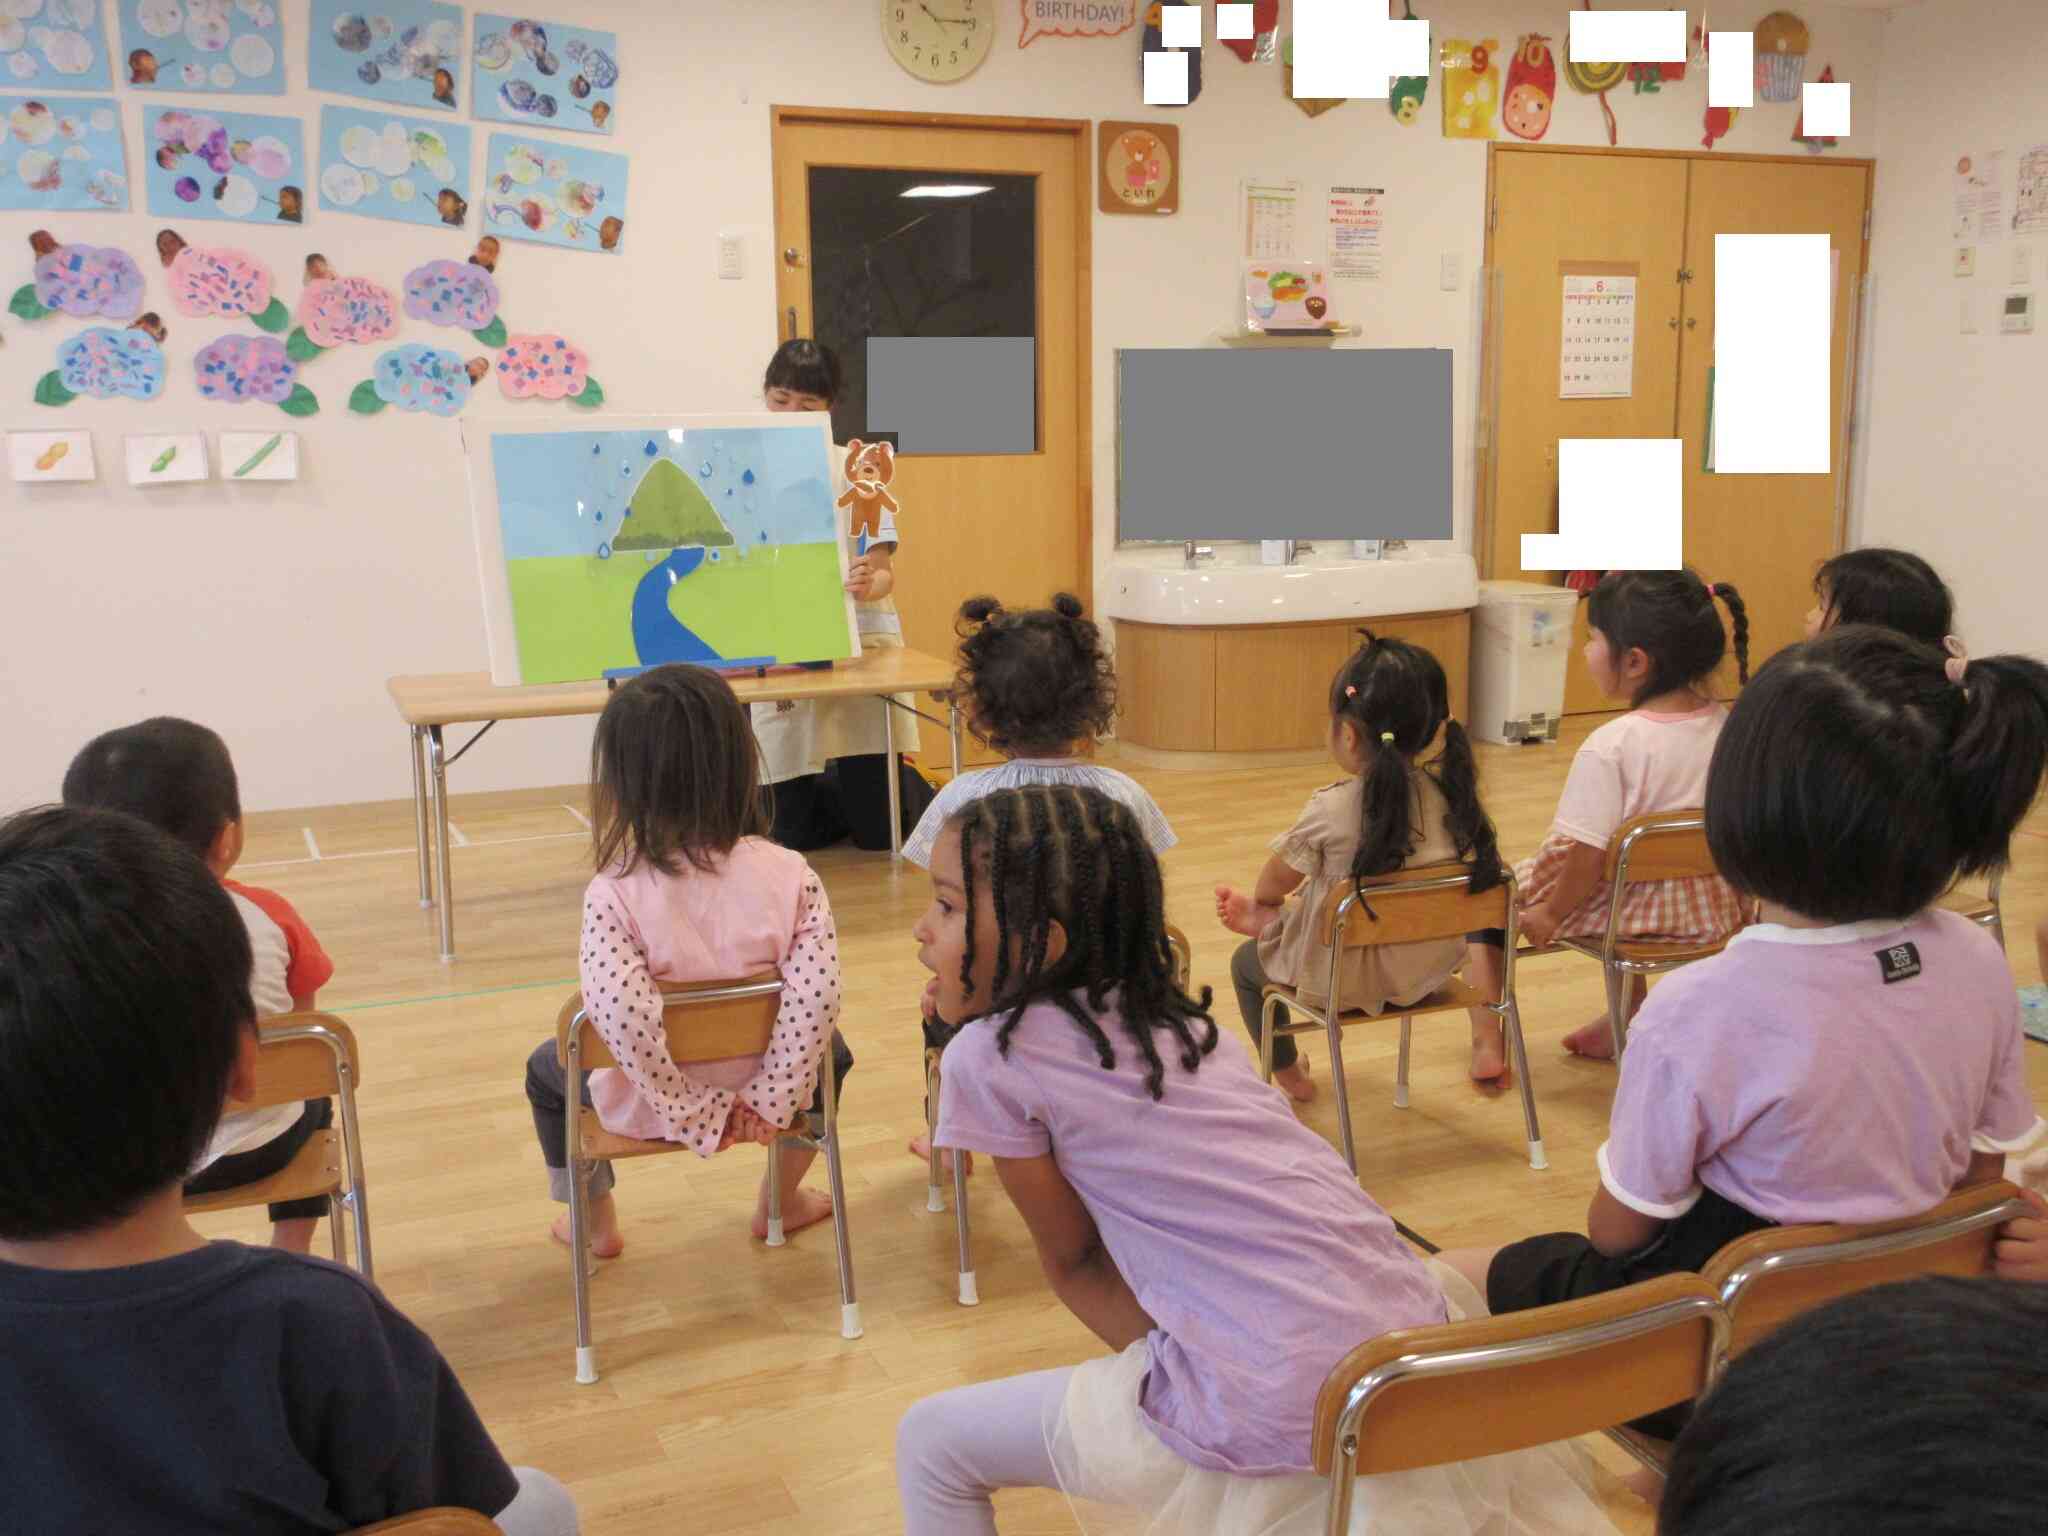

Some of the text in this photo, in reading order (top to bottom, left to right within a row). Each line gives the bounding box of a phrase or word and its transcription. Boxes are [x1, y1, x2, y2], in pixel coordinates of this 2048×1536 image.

[895, 7, 904, 22] 9
[1035, 0, 1124, 22] BIRTHDAY!
[899, 30, 909, 44] 8
[961, 36, 969, 49] 4
[912, 45, 921, 62] 7
[930, 53, 940, 68] 6
[949, 50, 959, 64] 5
[1471, 46, 1489, 74] 9
[1517, 37, 1545, 68] 10
[1633, 63, 1661, 95] 12
[1398, 96, 1419, 126] 8
[1596, 280, 1604, 292] 6
